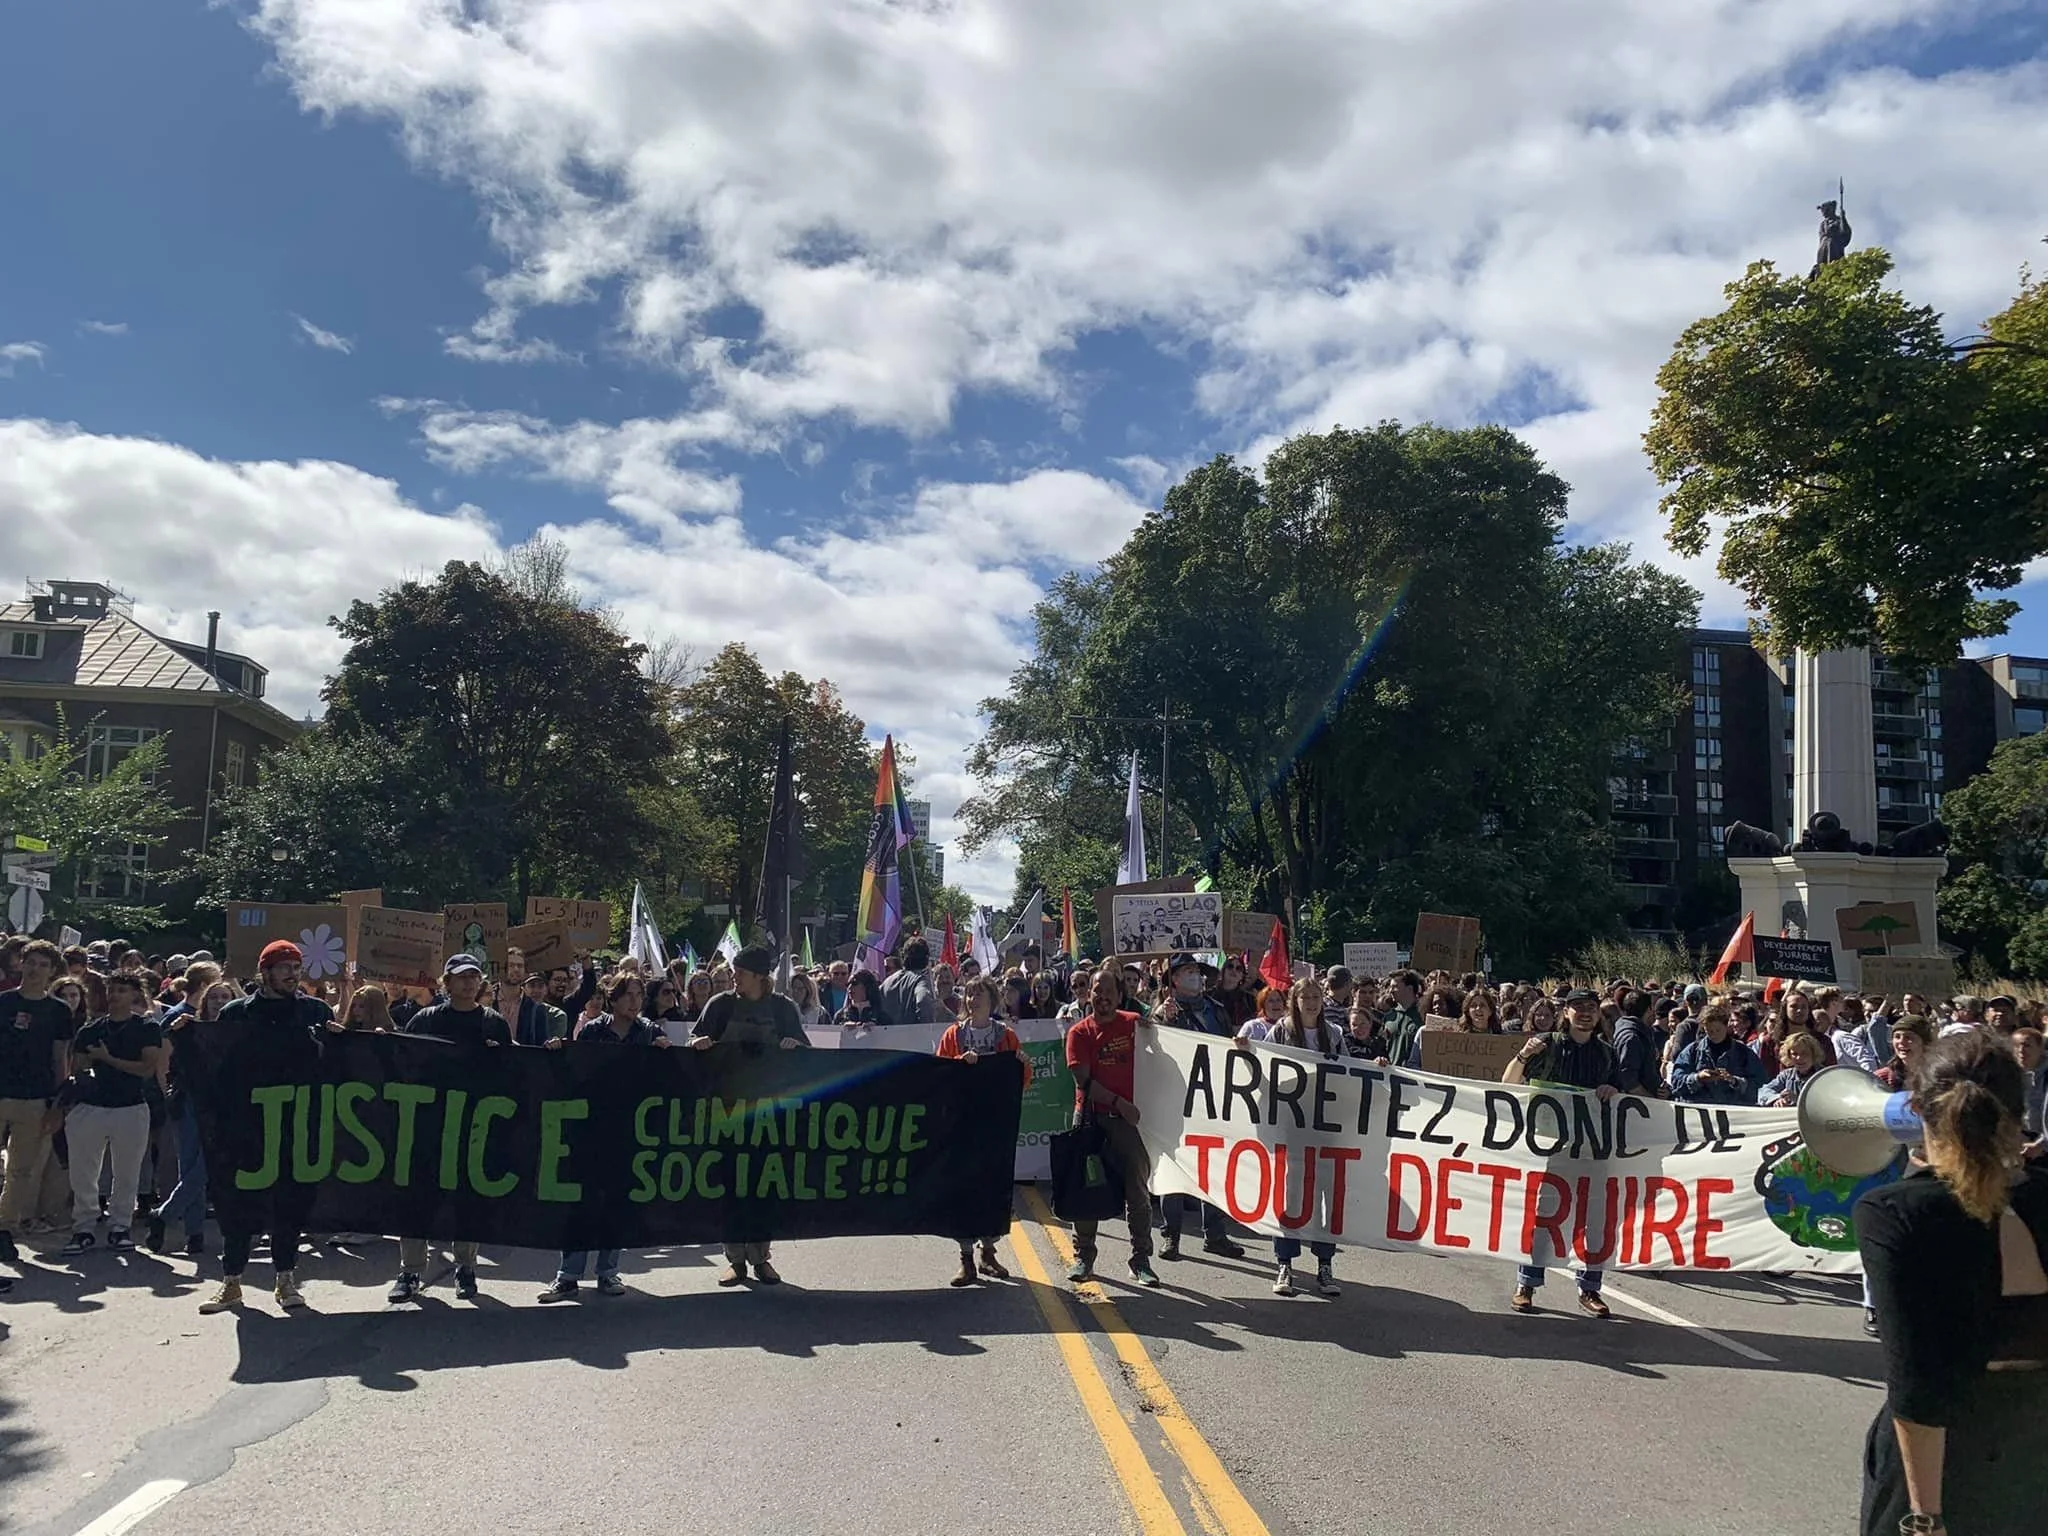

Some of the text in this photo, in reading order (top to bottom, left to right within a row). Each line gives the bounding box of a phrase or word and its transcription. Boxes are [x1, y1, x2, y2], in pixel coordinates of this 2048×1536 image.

[235, 1082, 589, 1202] JUSTICE
[634, 1096, 928, 1153] CLIMATIQUE
[1481, 1089, 1651, 1160] DONC
[1185, 1134, 1735, 1270] TOUT DÉTRUIRE
